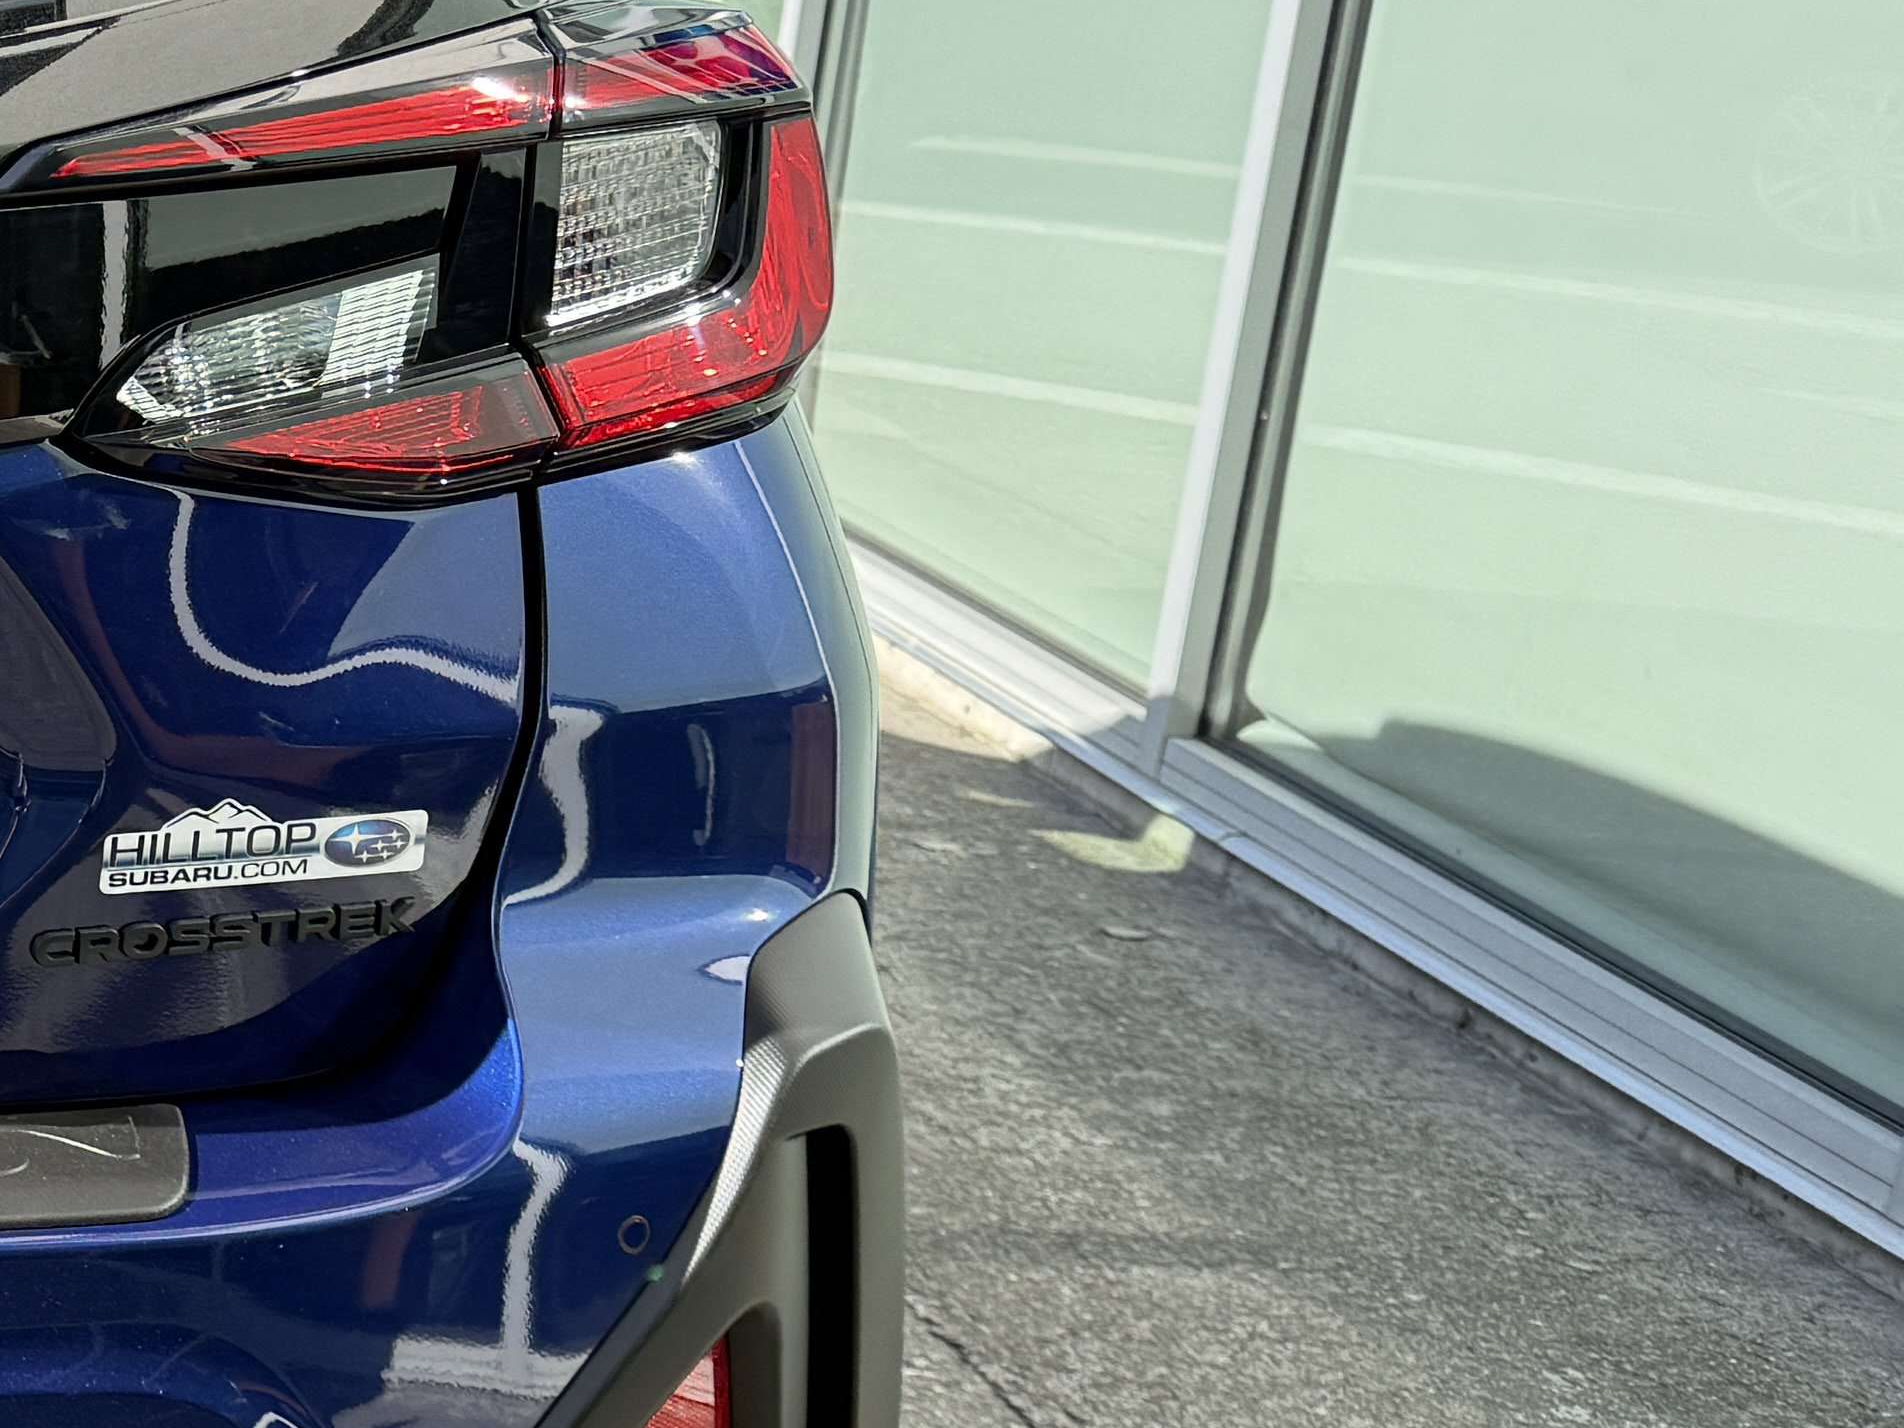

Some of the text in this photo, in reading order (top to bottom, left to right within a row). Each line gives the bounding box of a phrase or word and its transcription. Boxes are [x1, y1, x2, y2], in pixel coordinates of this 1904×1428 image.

[110, 823, 317, 868] HILLTOP
[108, 859, 308, 888] SUBARU.COM
[31, 897, 417, 967] CROSSTREK
